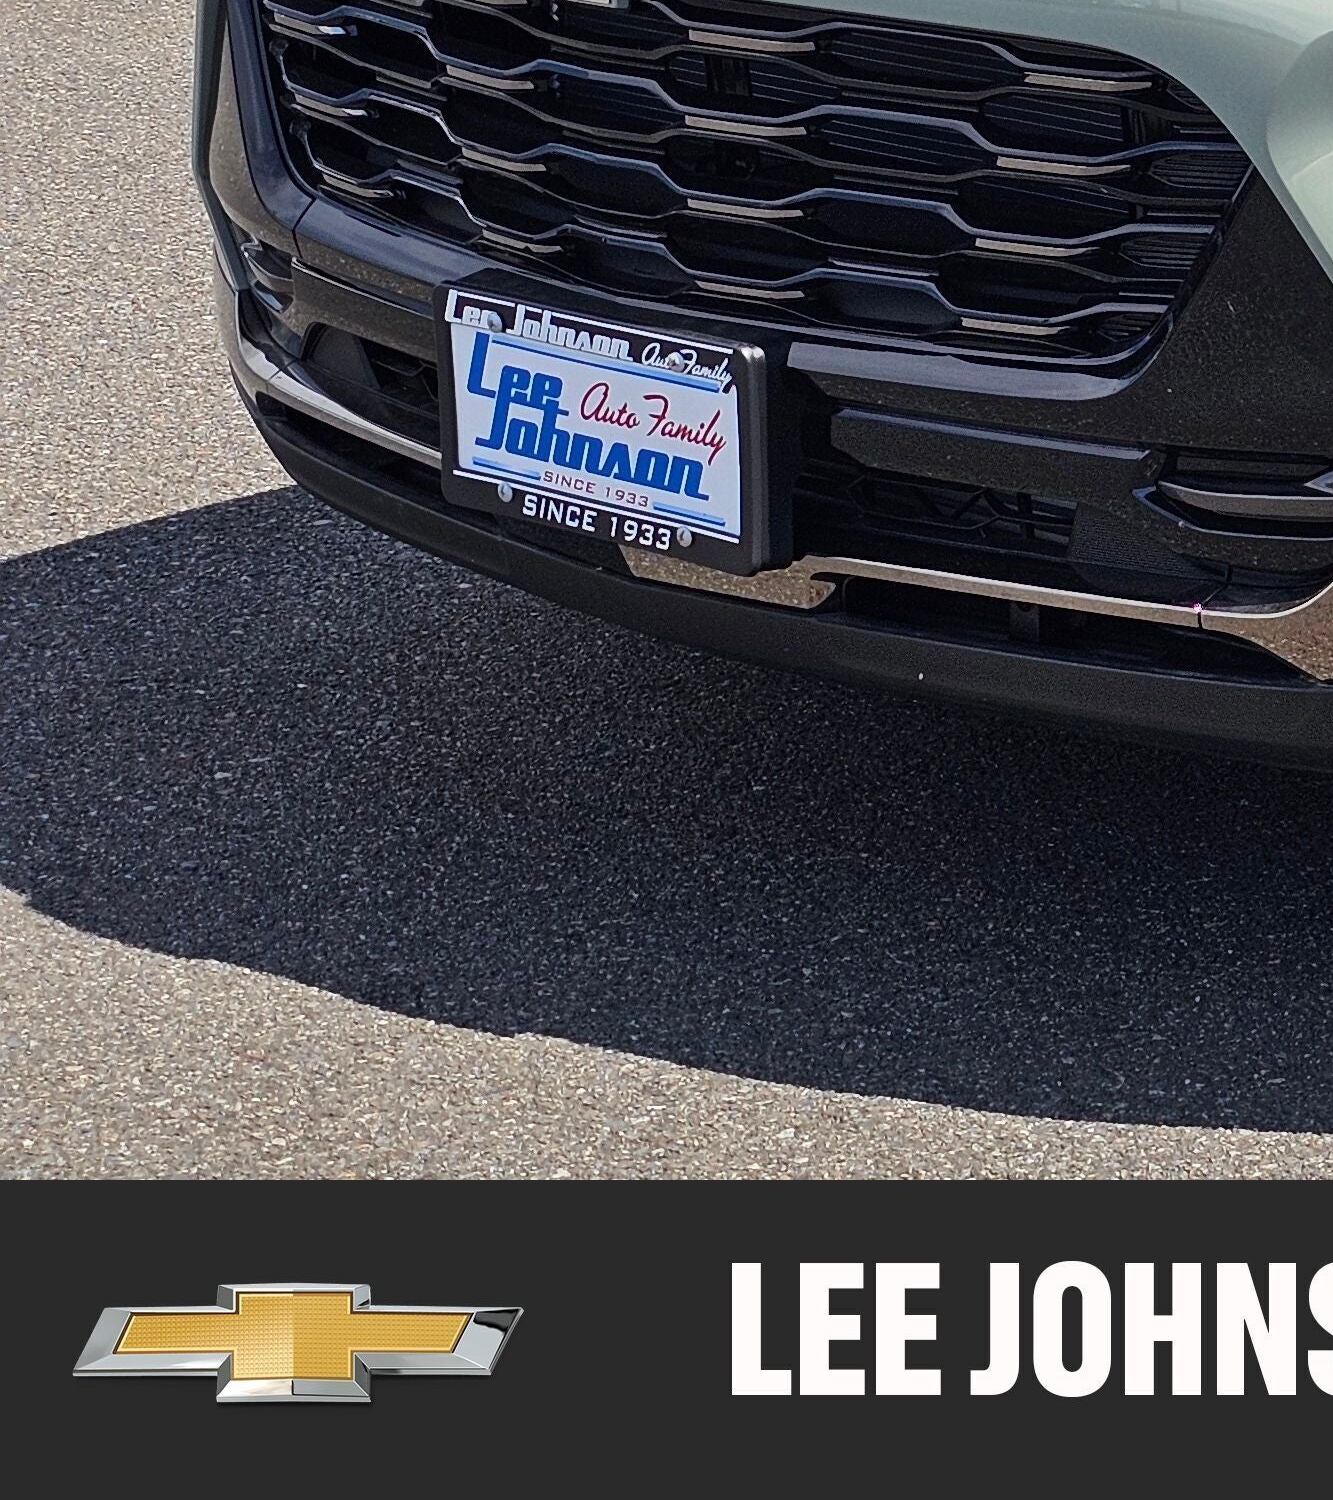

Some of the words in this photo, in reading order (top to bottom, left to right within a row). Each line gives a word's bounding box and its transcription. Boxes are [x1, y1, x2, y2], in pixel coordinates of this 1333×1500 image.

[467, 332, 569, 417] Lee
[505, 303, 633, 362] Johnson
[680, 350, 733, 387] Family
[474, 395, 710, 501] Johnson
[580, 382, 641, 430] Auto
[643, 394, 727, 467] Family
[521, 494, 598, 533] SINCE
[609, 516, 672, 551] 1933
[542, 470, 598, 495] SINCE
[604, 486, 650, 508] 1933
